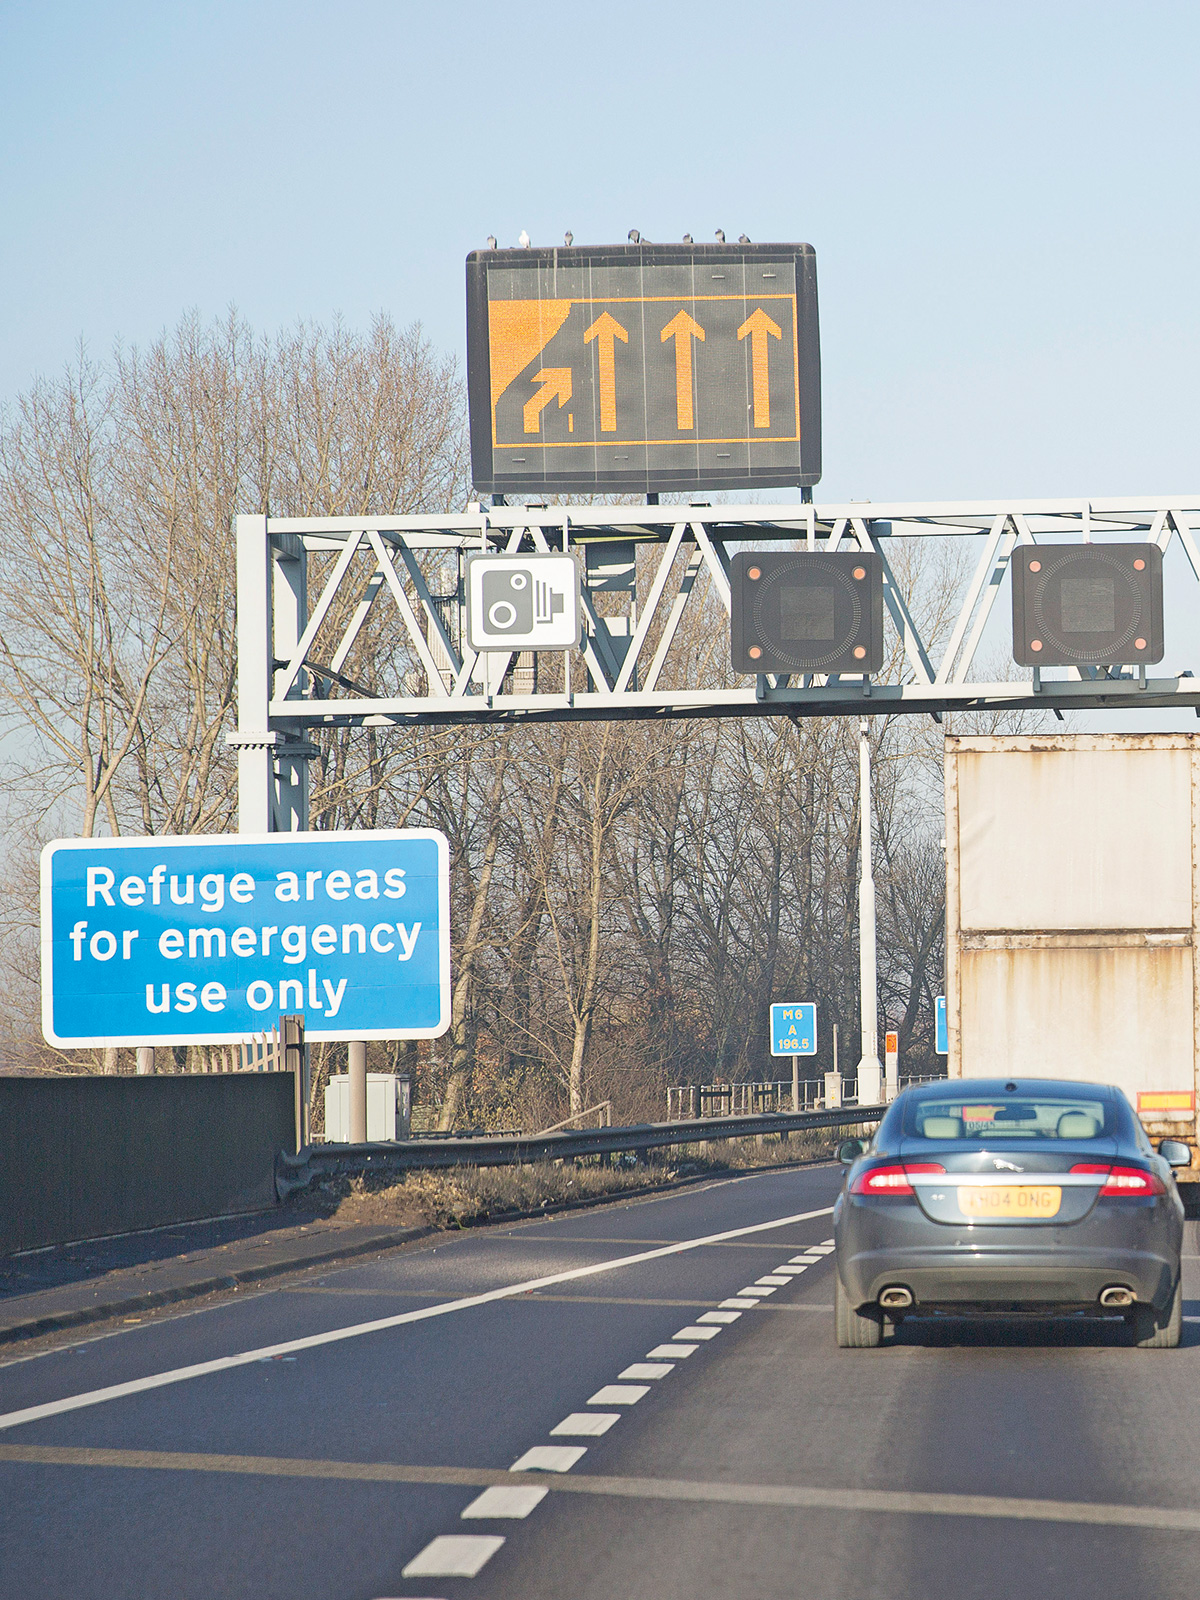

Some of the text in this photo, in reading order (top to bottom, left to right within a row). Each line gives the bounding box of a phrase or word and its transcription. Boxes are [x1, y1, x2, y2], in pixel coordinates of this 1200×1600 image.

[86, 864, 407, 912] Refuge areas
[69, 921, 422, 965] for emergency
[145, 969, 348, 1017] use only
[782, 1009, 803, 1020] M6
[778, 1038, 810, 1050] 196.5
[788, 1024, 797, 1036] A
